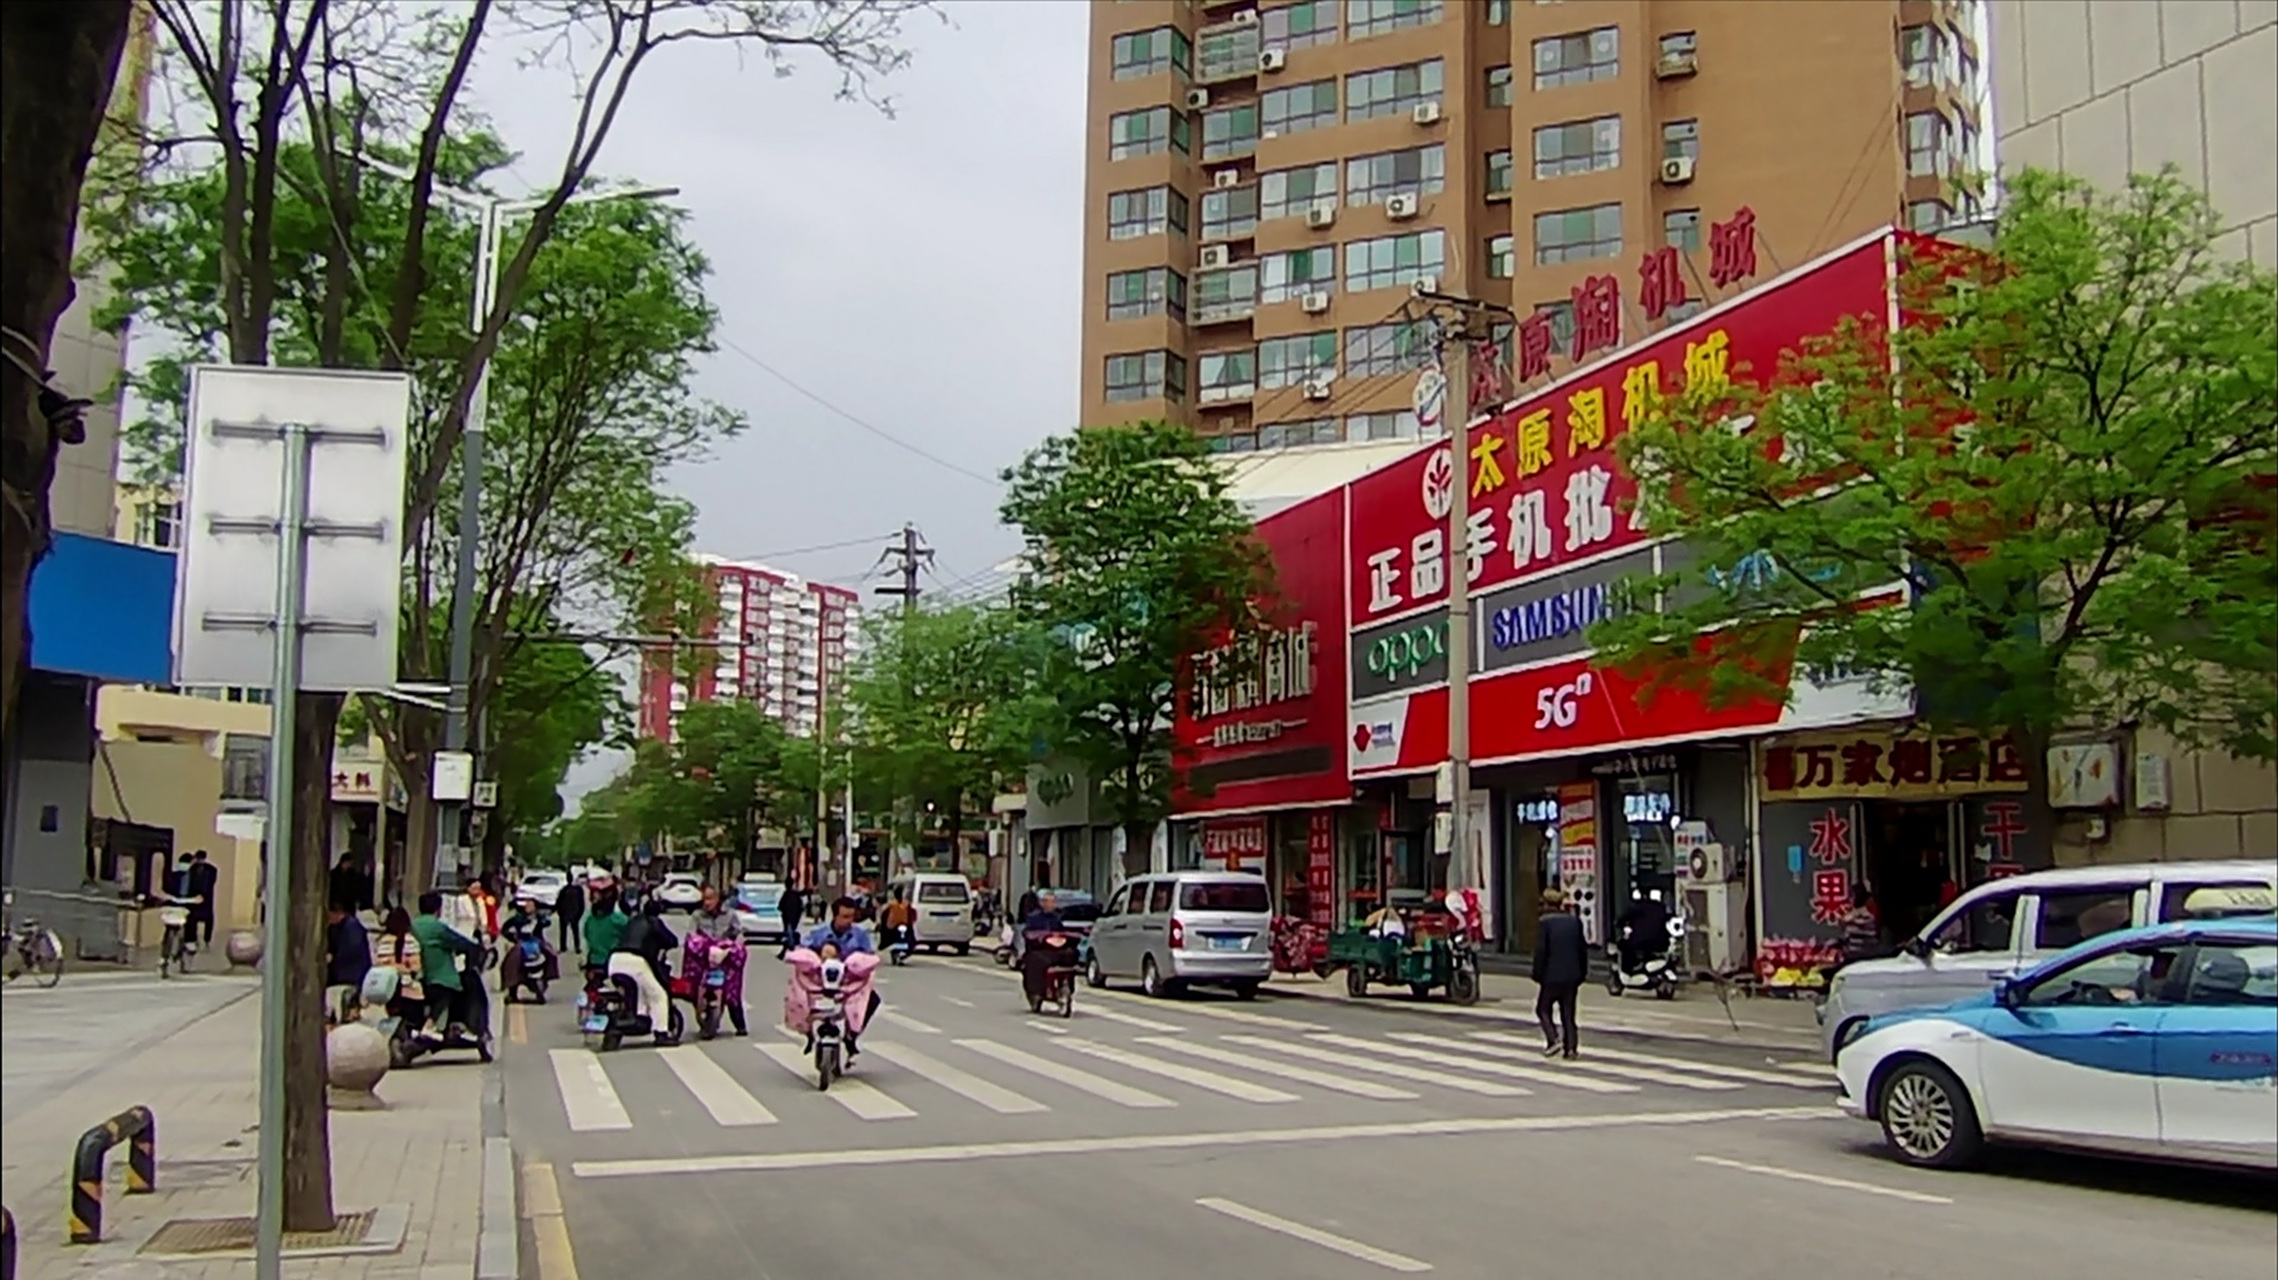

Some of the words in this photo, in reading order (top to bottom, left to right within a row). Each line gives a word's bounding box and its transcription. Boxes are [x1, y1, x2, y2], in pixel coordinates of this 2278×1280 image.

[1471, 329, 1733, 498] 太原淘机城
[1367, 464, 1650, 612] 正品手机批
[1493, 578, 1633, 652] SAMSUN
[1809, 807, 1854, 926] 水果
